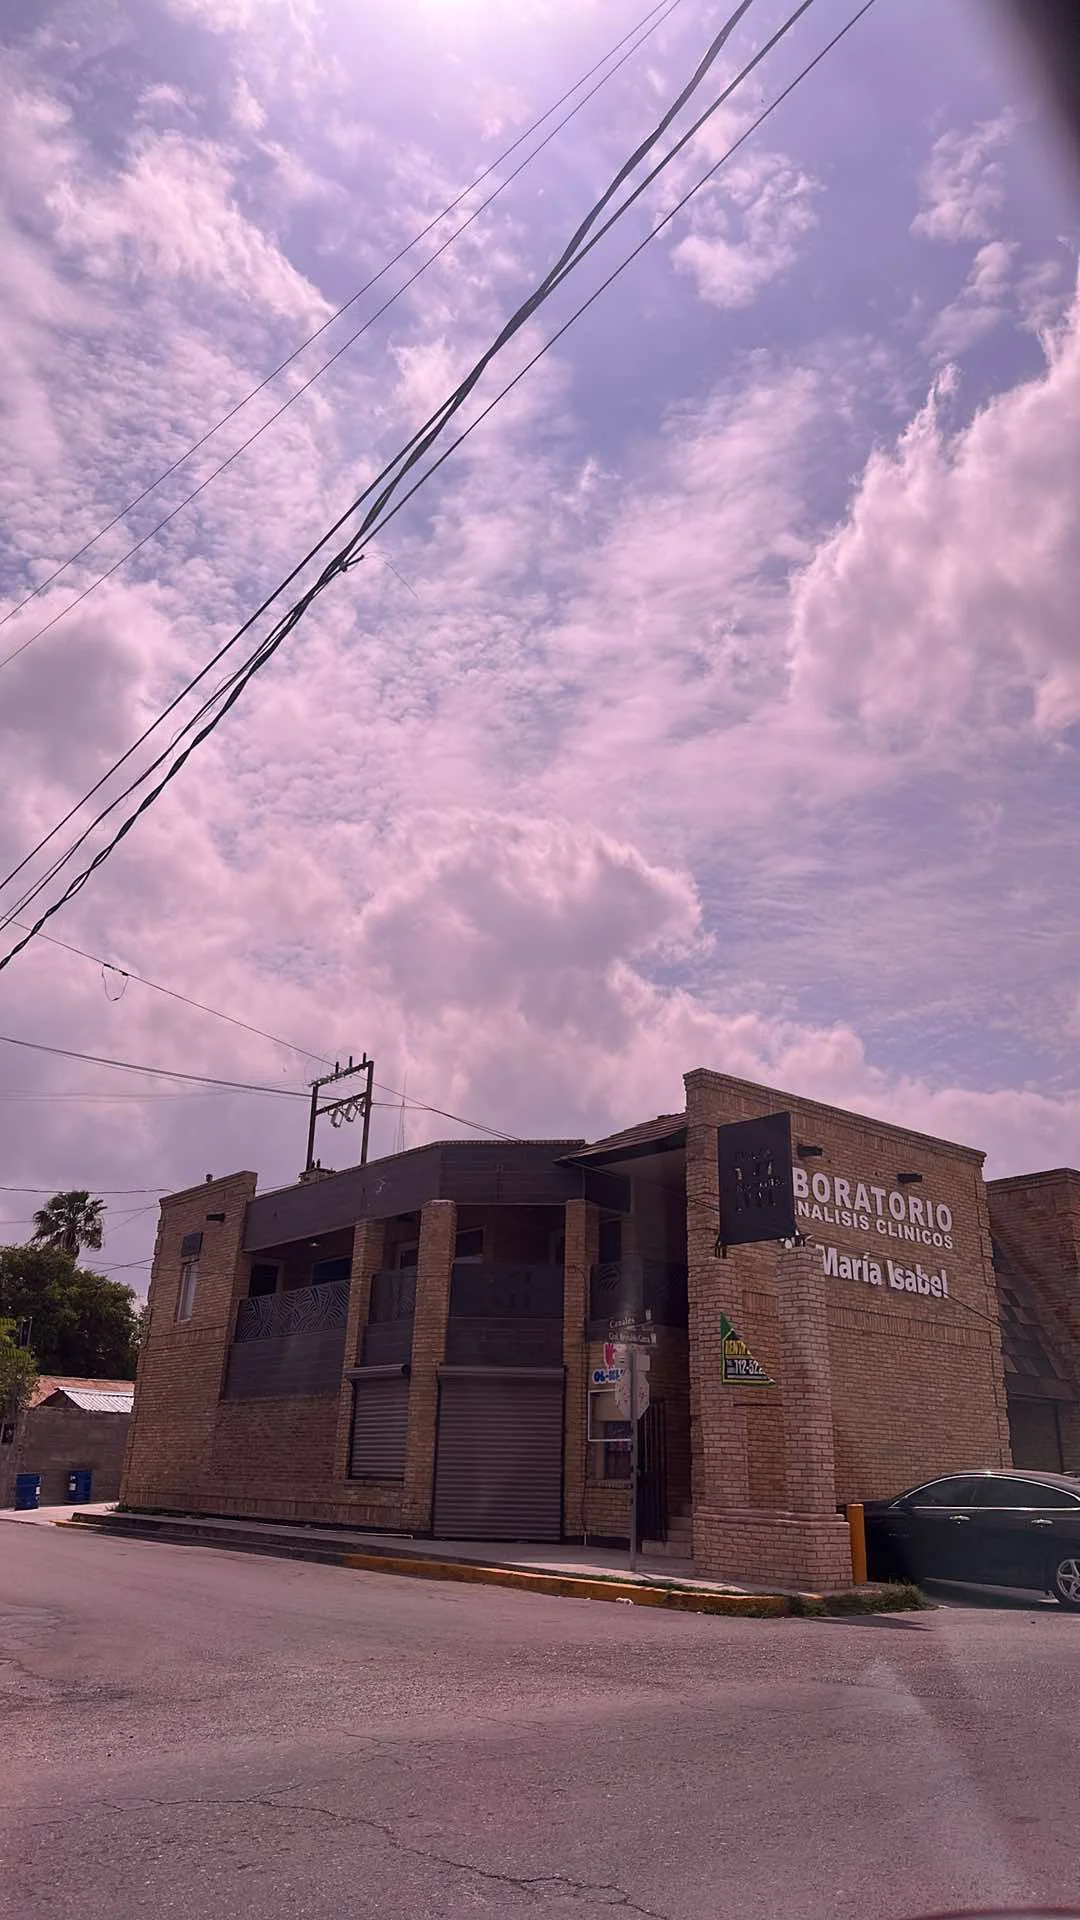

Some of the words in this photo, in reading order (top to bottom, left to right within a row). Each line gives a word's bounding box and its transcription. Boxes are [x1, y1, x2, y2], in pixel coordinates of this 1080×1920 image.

[792, 1167, 953, 1233] BORATORIO
[794, 1200, 870, 1231] NALISIS
[876, 1219, 953, 1250] CLINICOS
[817, 1244, 883, 1286] María
[887, 1259, 950, 1299] Isabel
